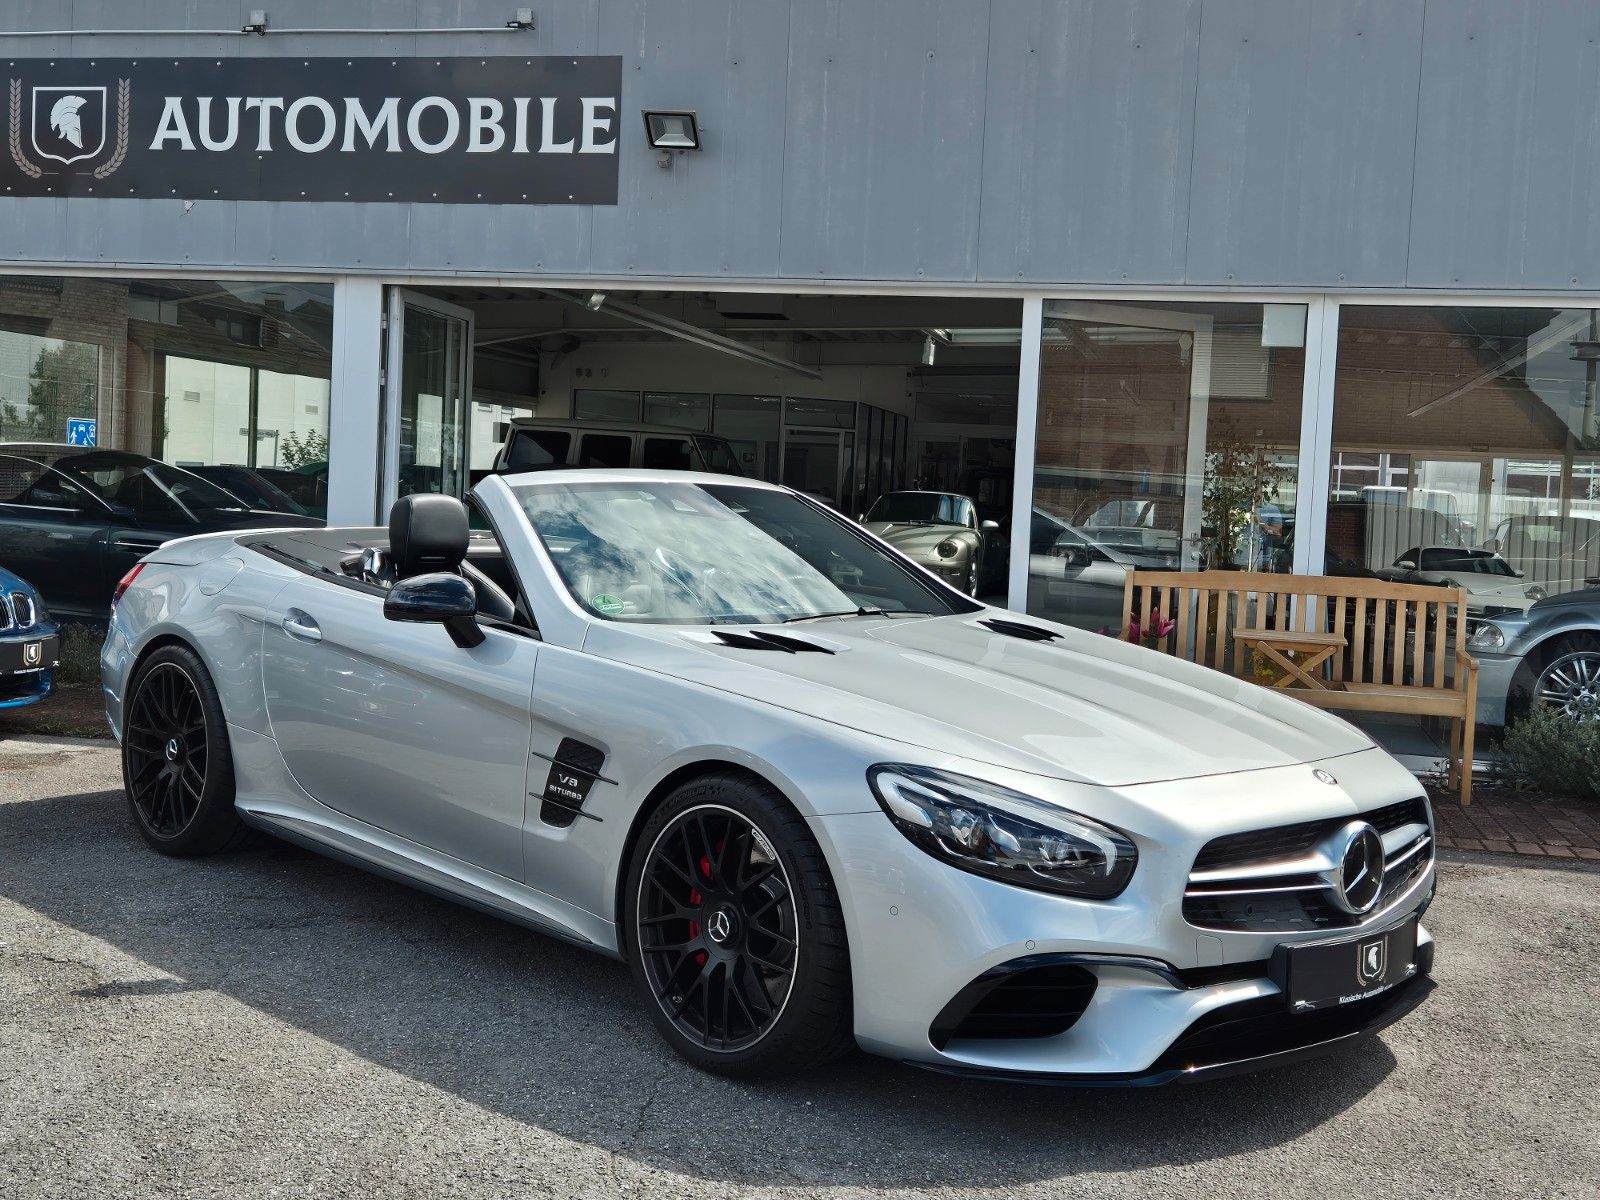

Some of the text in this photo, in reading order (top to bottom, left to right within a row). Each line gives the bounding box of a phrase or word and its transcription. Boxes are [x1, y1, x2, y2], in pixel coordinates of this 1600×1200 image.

[148, 96, 617, 154] AUTOMOBILE
[559, 773, 577, 787] V8
[549, 784, 582, 800] BITURBO
